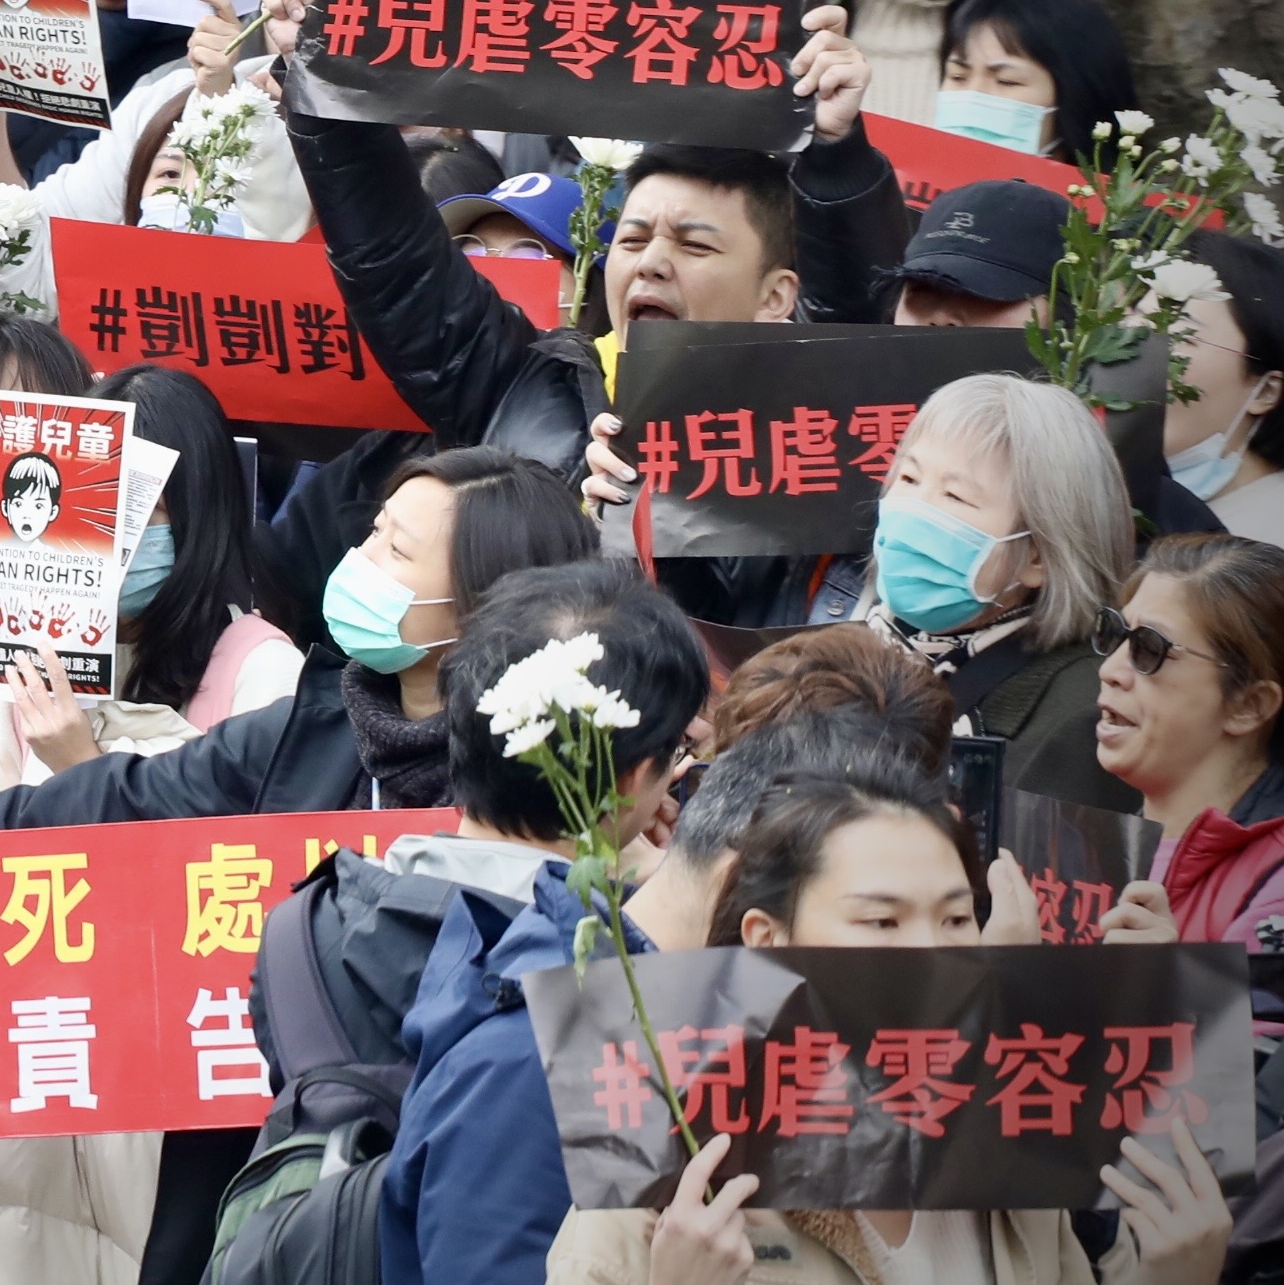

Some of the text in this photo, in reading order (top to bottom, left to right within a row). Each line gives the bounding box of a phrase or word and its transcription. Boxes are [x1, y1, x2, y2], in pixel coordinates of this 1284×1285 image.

[19, 15, 32, 24] TO
[33, 16, 85, 29] CHILDREN'S
[19, 24, 87, 46] RIGHTS!
[89, 286, 365, 381] #剴剴對
[28, 551, 41, 561] TO
[43, 552, 104, 567] CHILDREN'S
[24, 564, 102, 588] RIGHTS!
[8, 583, 38, 593] TRAGEDY
[40, 586, 71, 597] HAPPEN
[592, 1020, 1210, 1141] #兒虐零容忍
